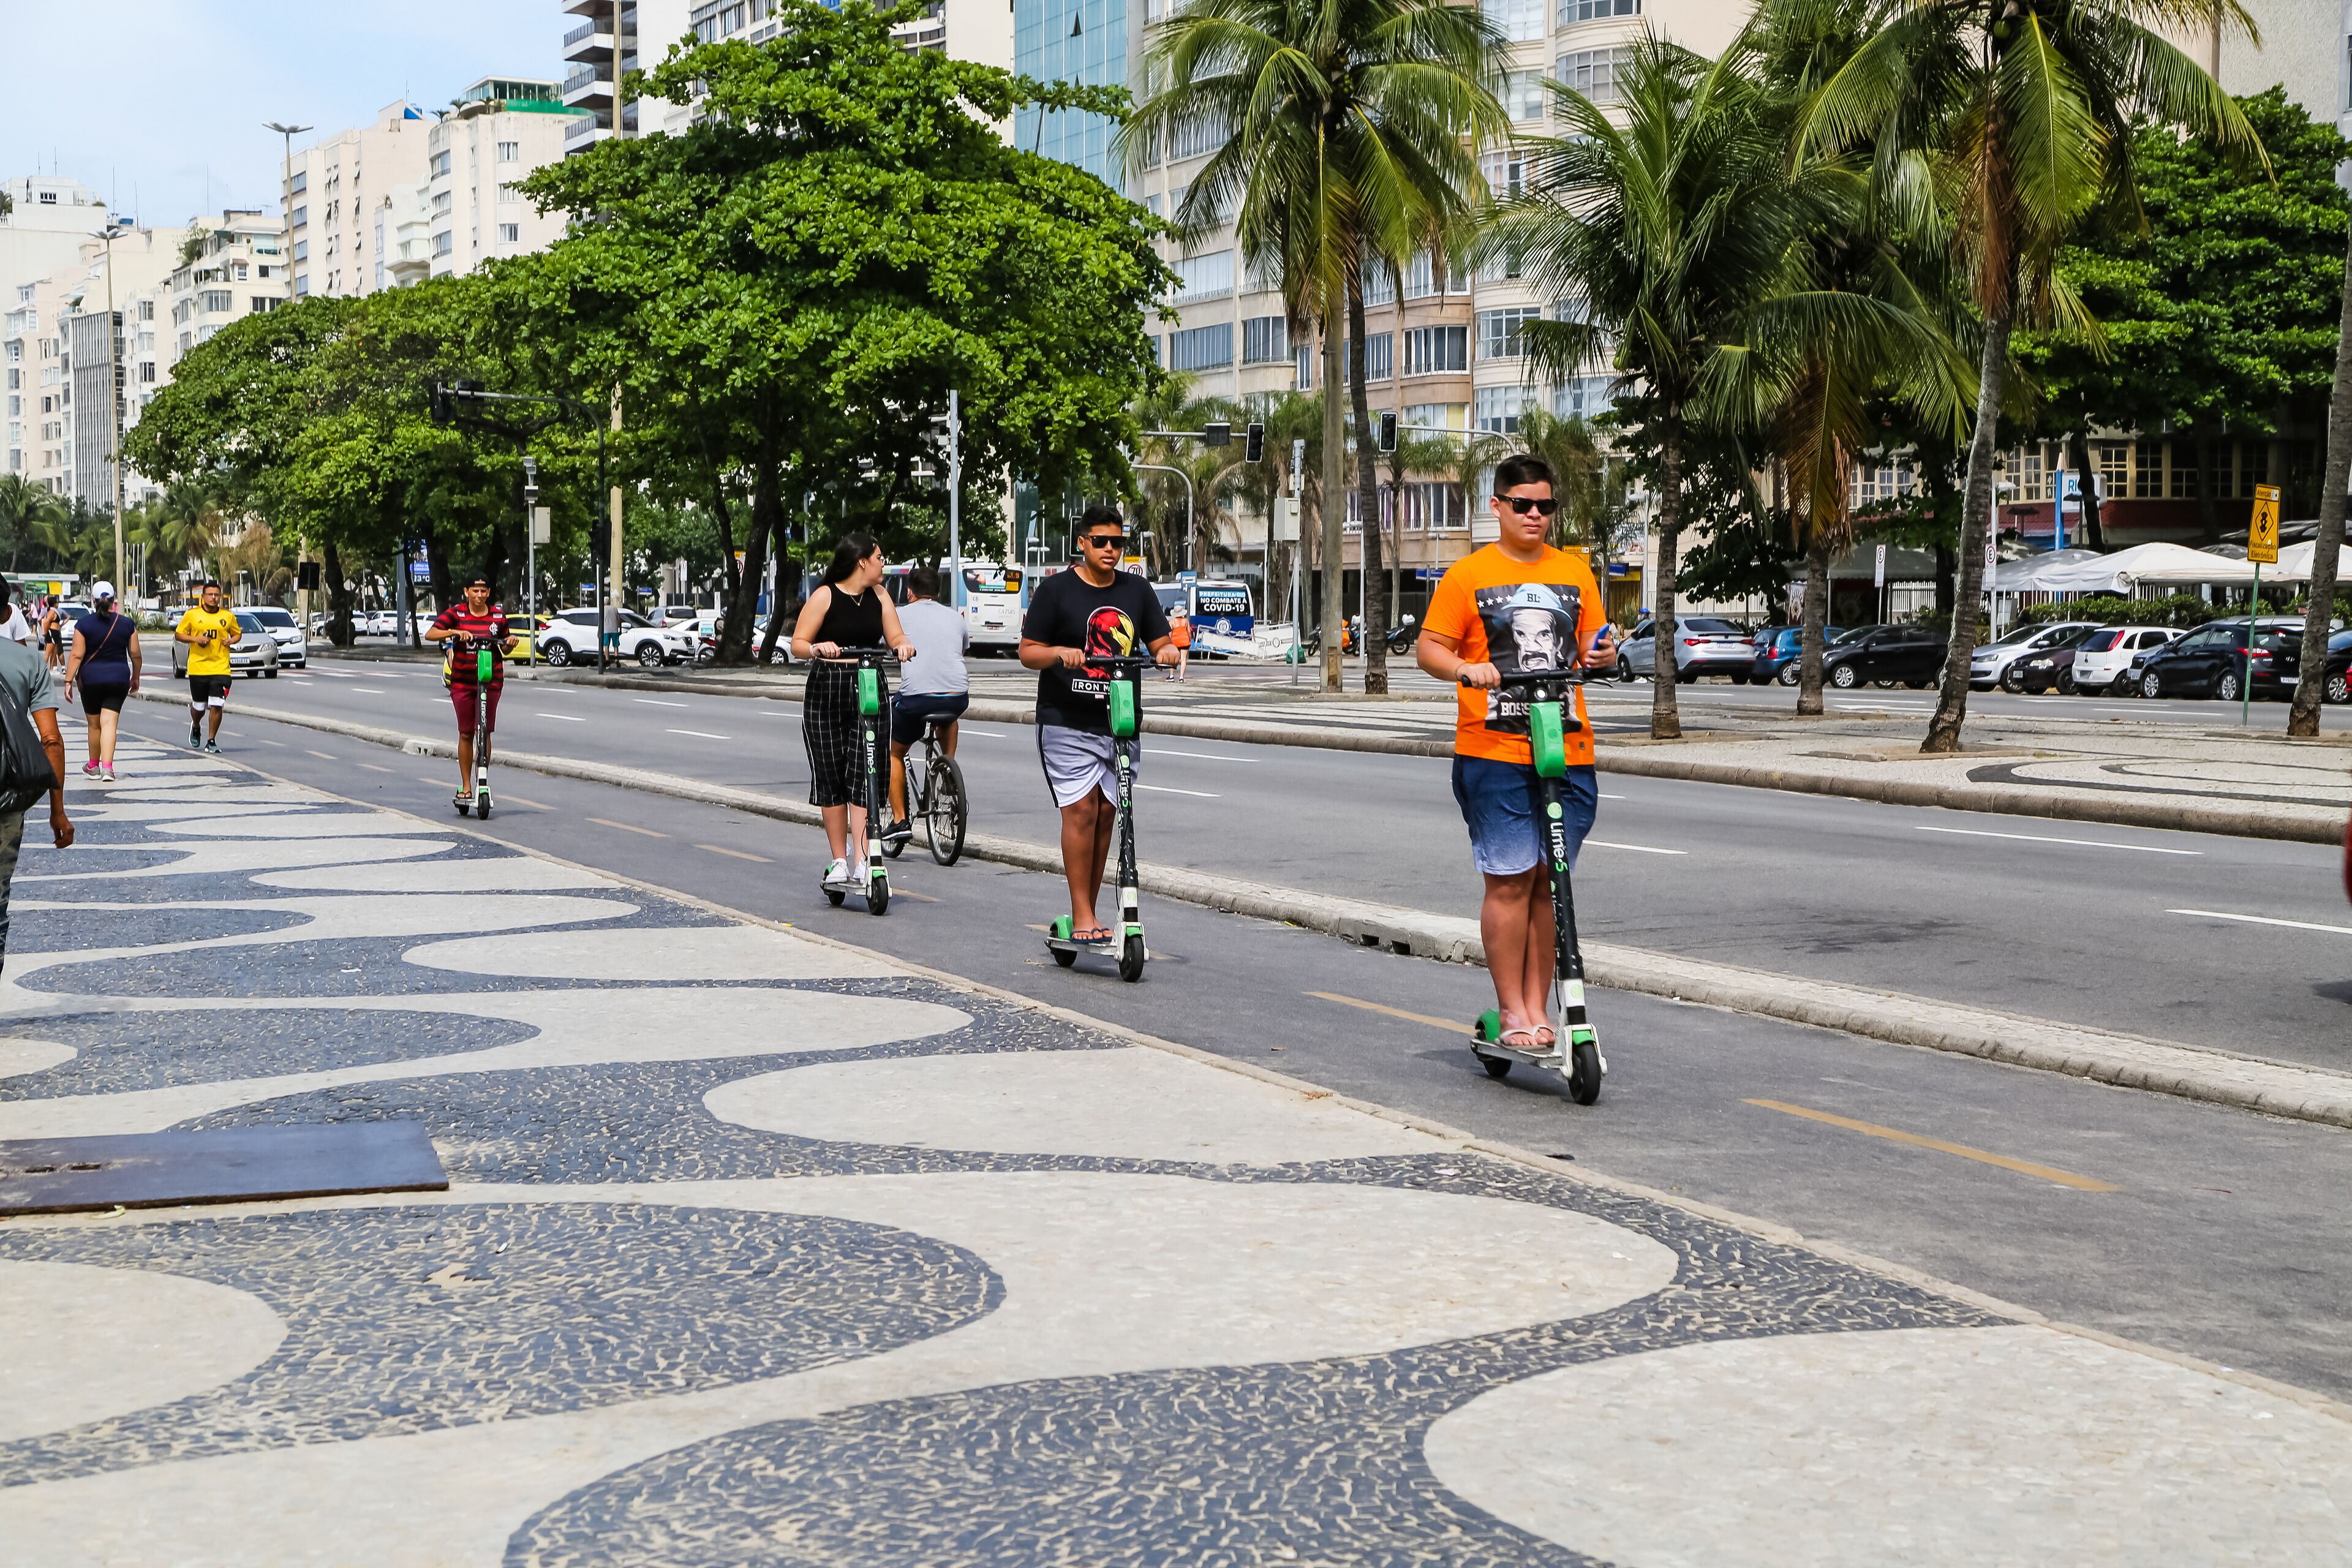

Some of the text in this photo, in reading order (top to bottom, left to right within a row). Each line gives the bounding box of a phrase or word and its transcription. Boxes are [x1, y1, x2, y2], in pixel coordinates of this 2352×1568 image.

[1131, 567, 1140, 575] 70
[1204, 603, 1245, 612] COVID-19
[1074, 681, 1099, 691] IRON
